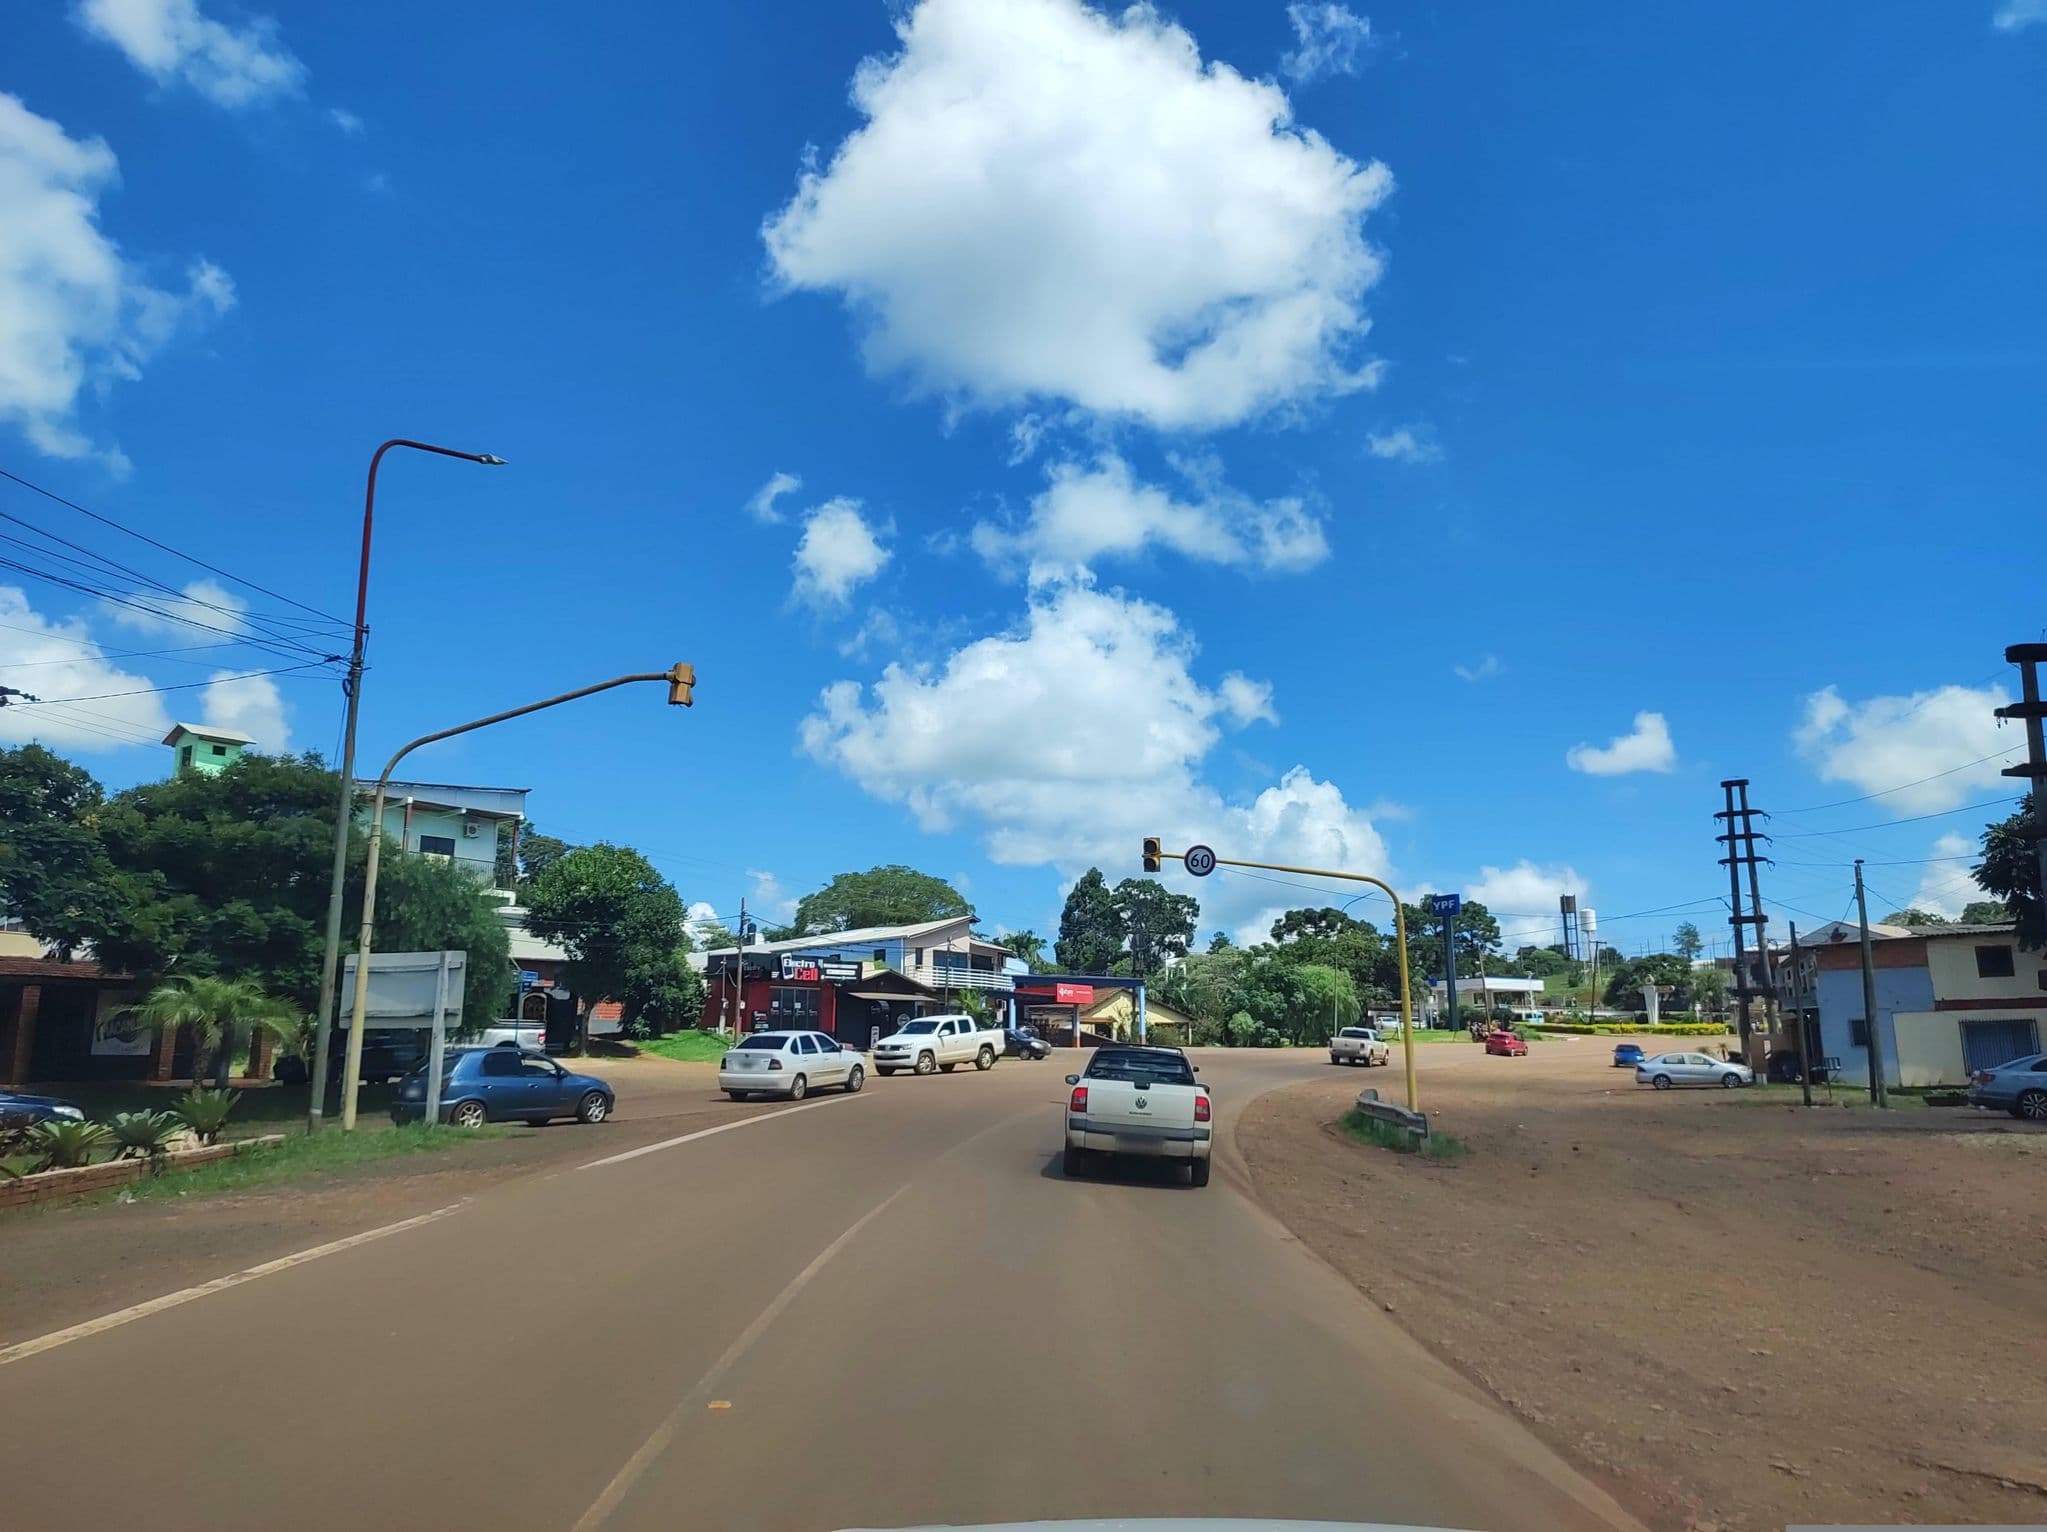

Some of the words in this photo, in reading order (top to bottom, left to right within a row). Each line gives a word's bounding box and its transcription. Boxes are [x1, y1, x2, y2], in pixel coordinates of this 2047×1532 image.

[1190, 854, 1210, 868] 60
[1433, 899, 1455, 911] YPF
[794, 967, 818, 981] Cell
